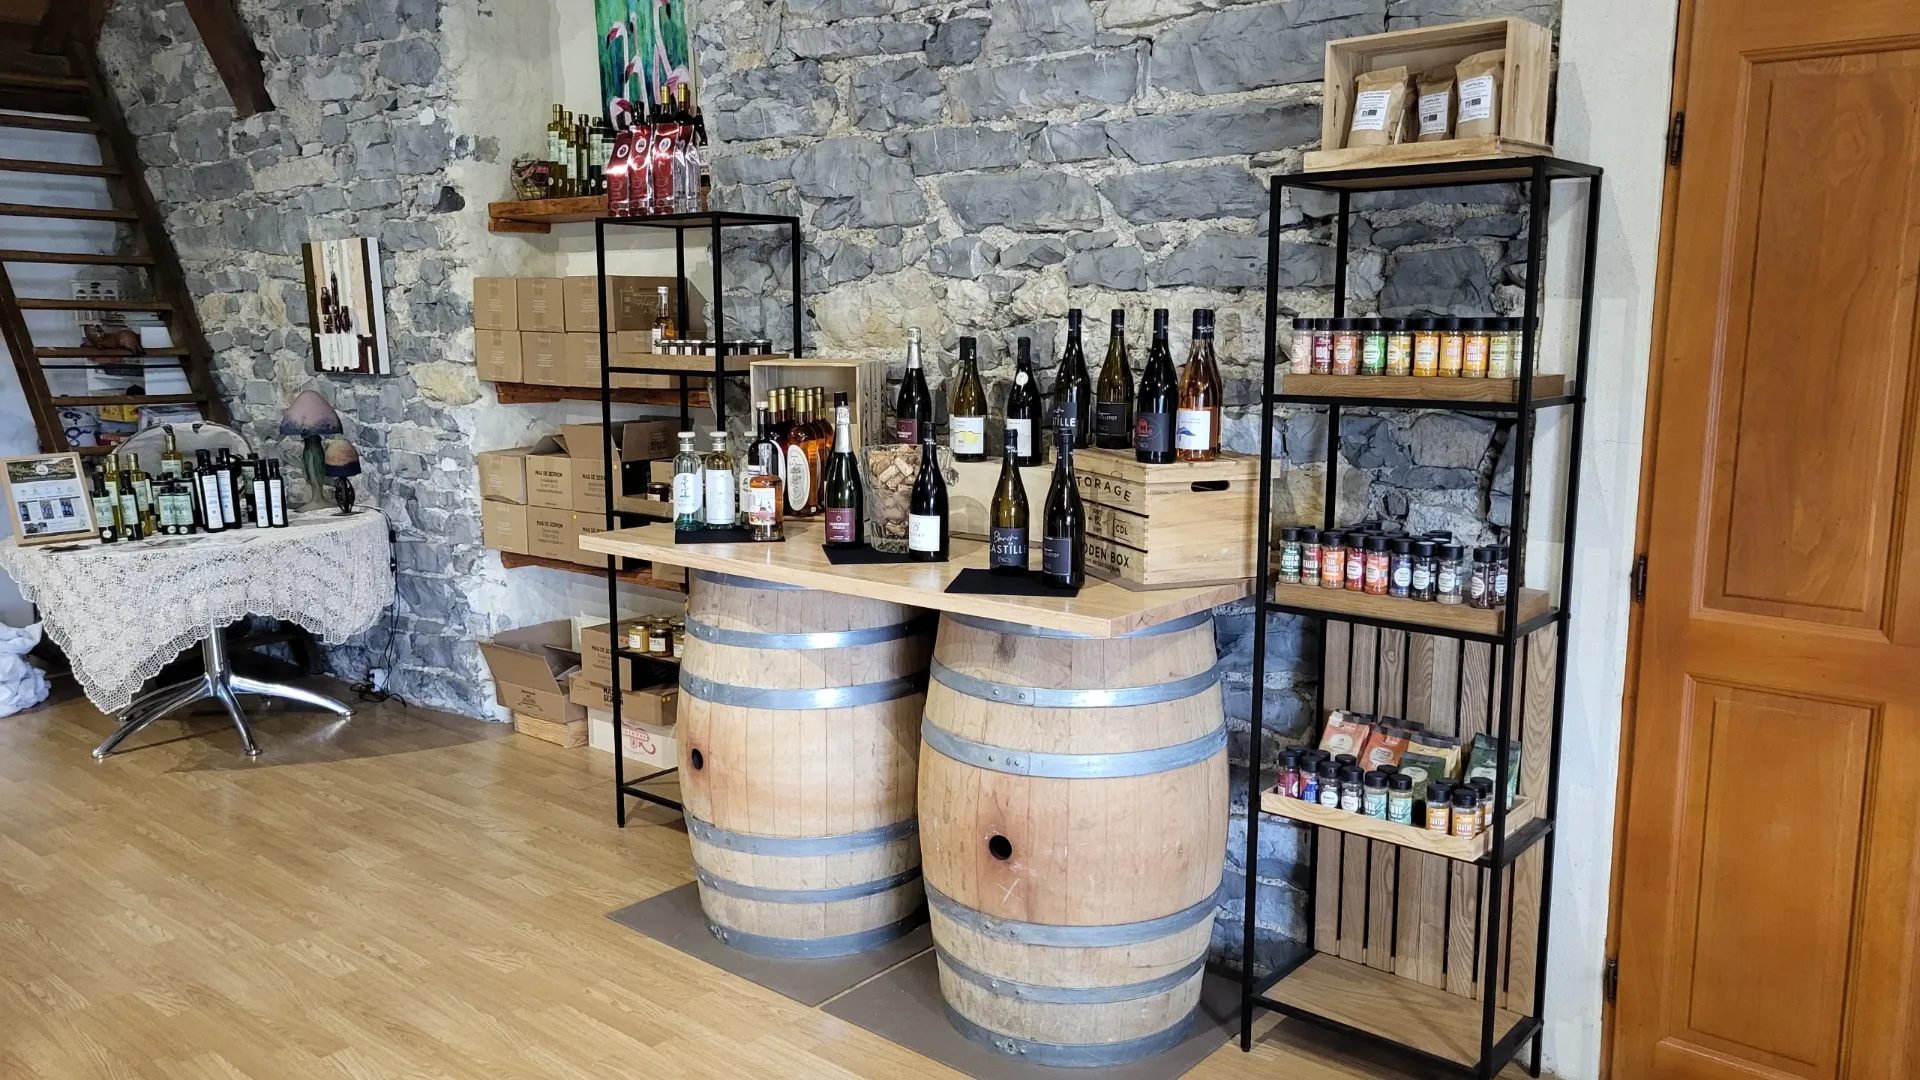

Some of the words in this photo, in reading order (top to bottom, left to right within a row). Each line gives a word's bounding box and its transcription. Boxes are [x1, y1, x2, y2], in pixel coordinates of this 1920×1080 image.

[1076, 476, 1132, 502] TORAGE
[1084, 541, 1107, 561] ODEN
[1110, 551, 1130, 569] BOX
